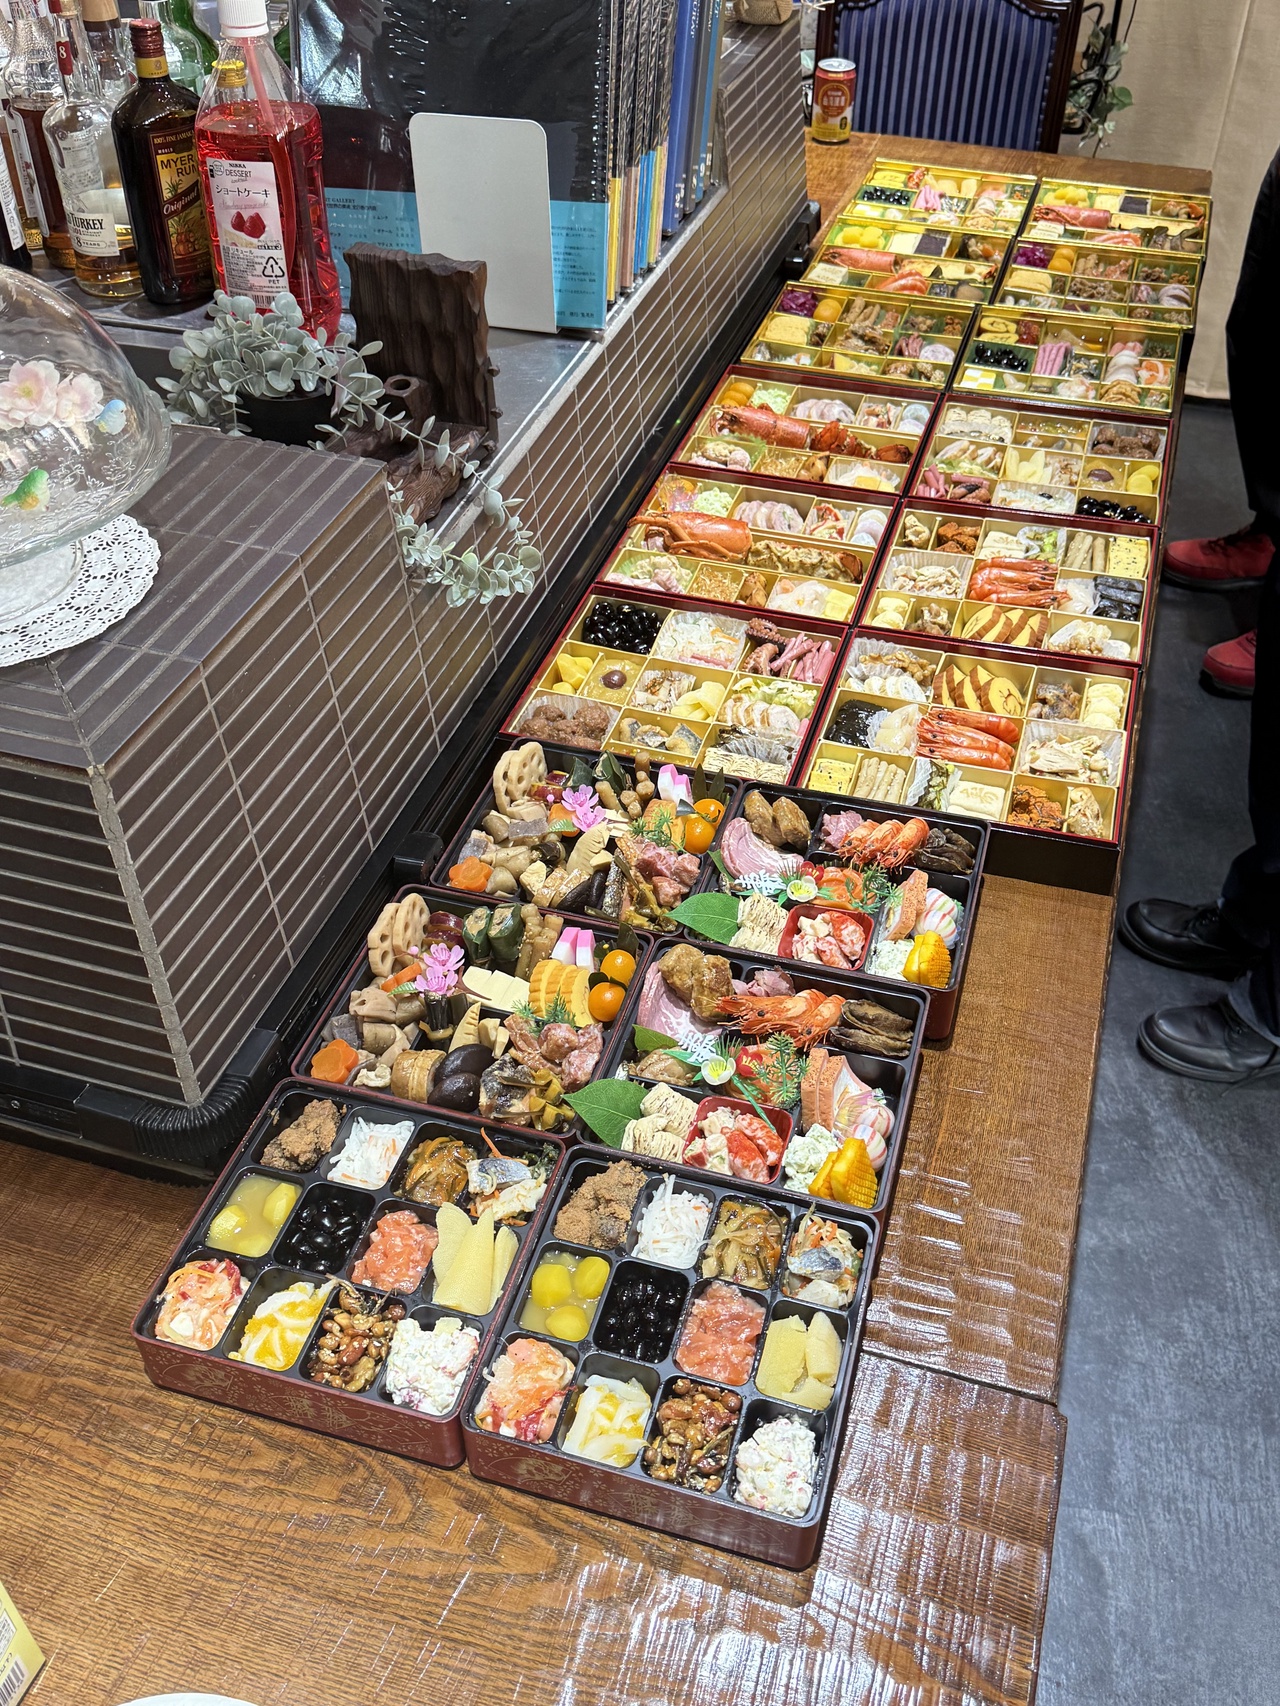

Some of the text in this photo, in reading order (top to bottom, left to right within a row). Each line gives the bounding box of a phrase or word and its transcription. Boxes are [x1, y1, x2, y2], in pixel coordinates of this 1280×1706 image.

[59, 46, 67, 58] 8
[225, 169, 252, 178] DESSERT
[215, 184, 271, 198] ショートケーキ
[163, 186, 198, 215] Original
[70, 212, 104, 231] TURKEY
[270, 264, 275, 274] 1
